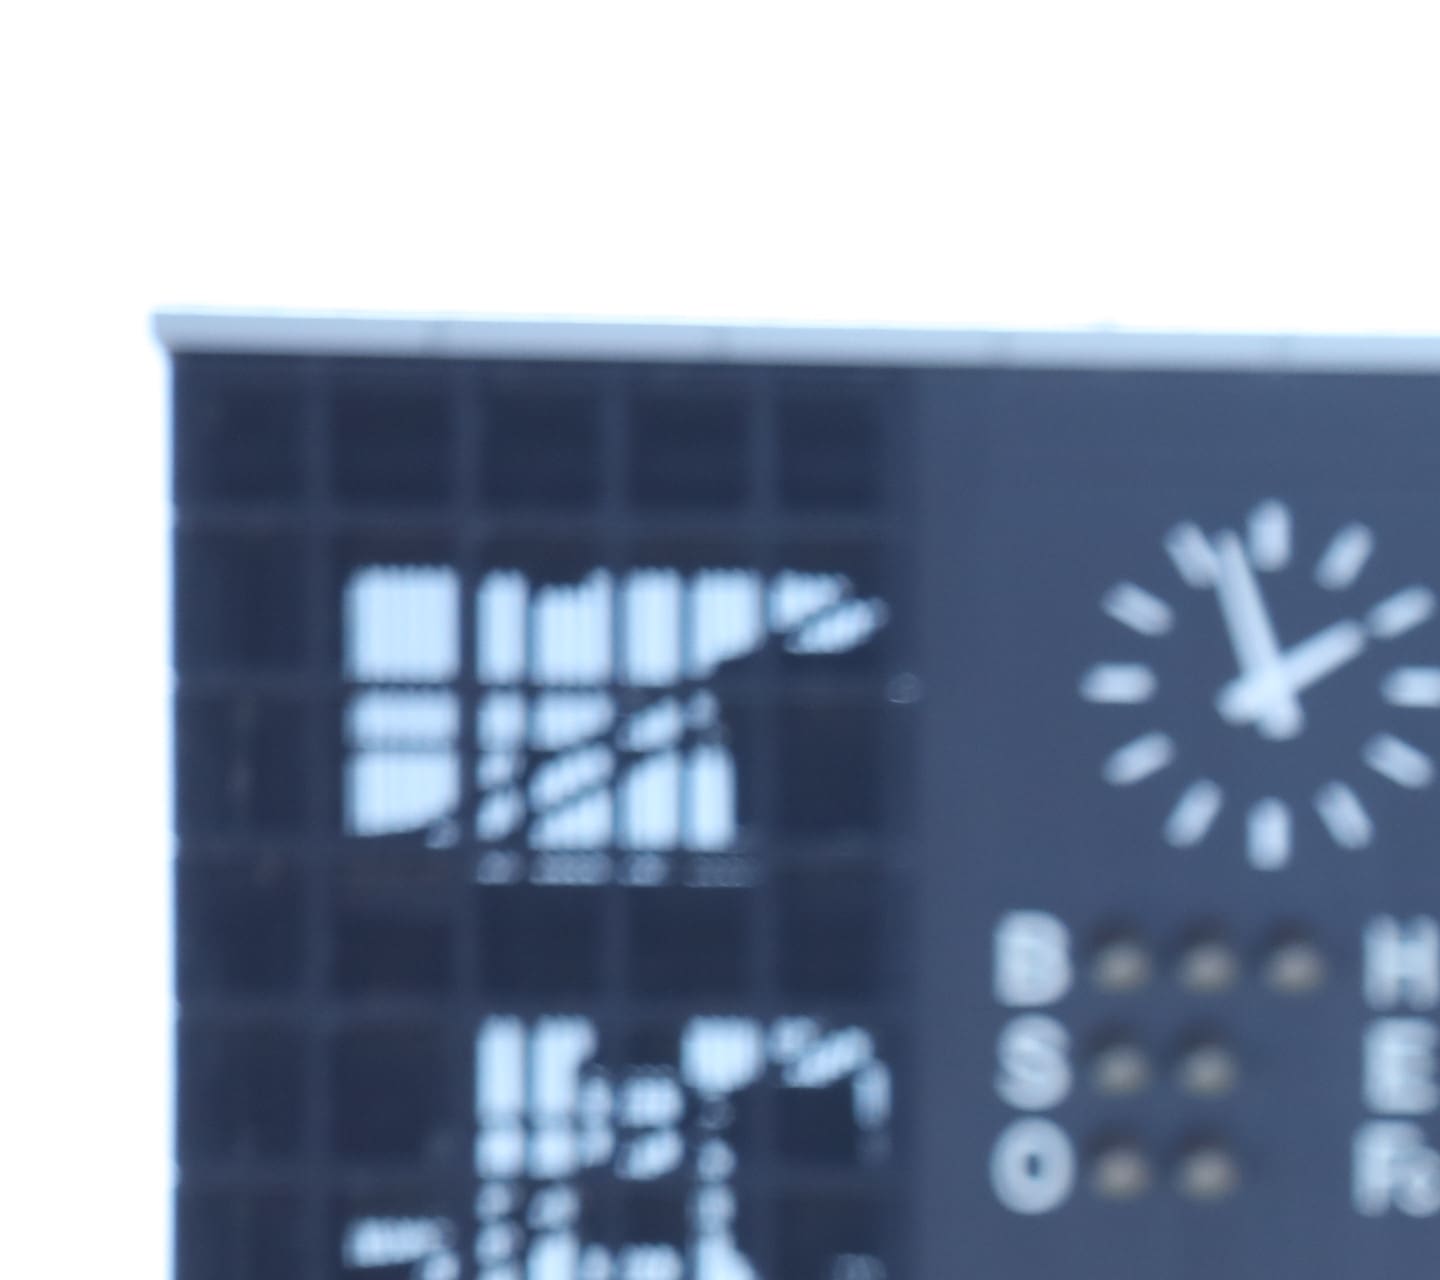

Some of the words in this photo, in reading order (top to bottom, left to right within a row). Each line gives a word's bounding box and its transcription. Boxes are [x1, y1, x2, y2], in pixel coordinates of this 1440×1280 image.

[995, 910, 1072, 1007] B
[998, 1015, 1071, 1111] S
[1363, 1018, 1440, 1114] E
